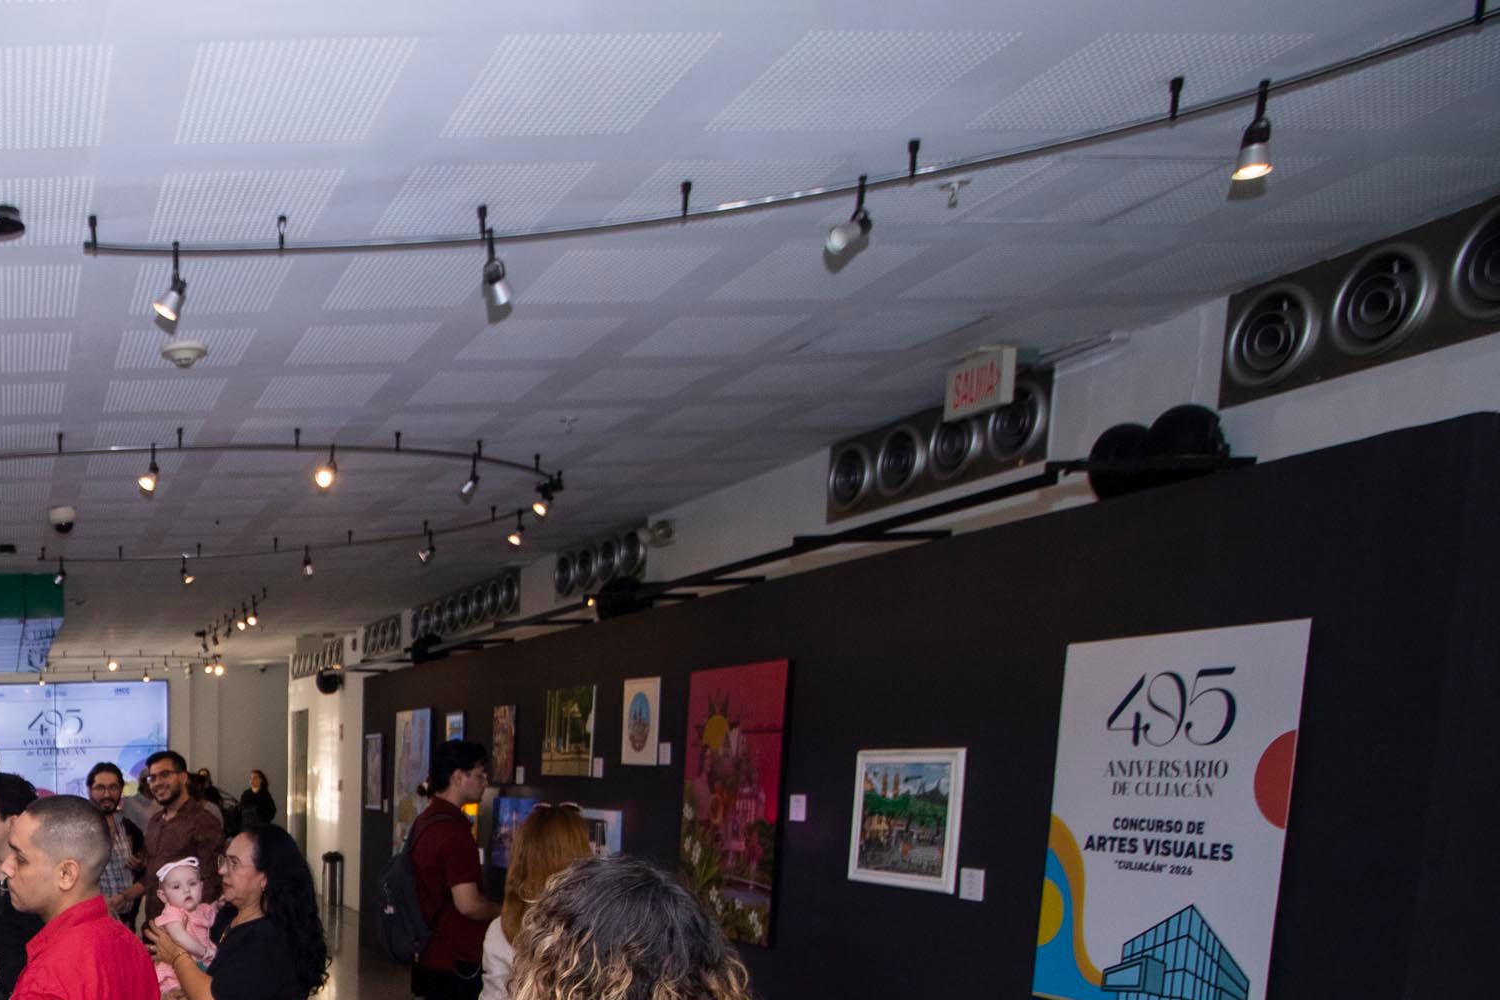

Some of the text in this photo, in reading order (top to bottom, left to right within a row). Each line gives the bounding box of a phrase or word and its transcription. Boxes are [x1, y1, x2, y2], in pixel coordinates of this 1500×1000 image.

[1107, 666, 1237, 747] 495
[27, 709, 83, 736] 495
[1104, 760, 1229, 779] ANIVERSARIO
[1112, 779, 1216, 798] DE CULIACÁN
[1113, 817, 1205, 835] CONCURSO DE
[1084, 835, 1234, 862] ARTES VISUALES
[1169, 864, 1193, 876] 2026
